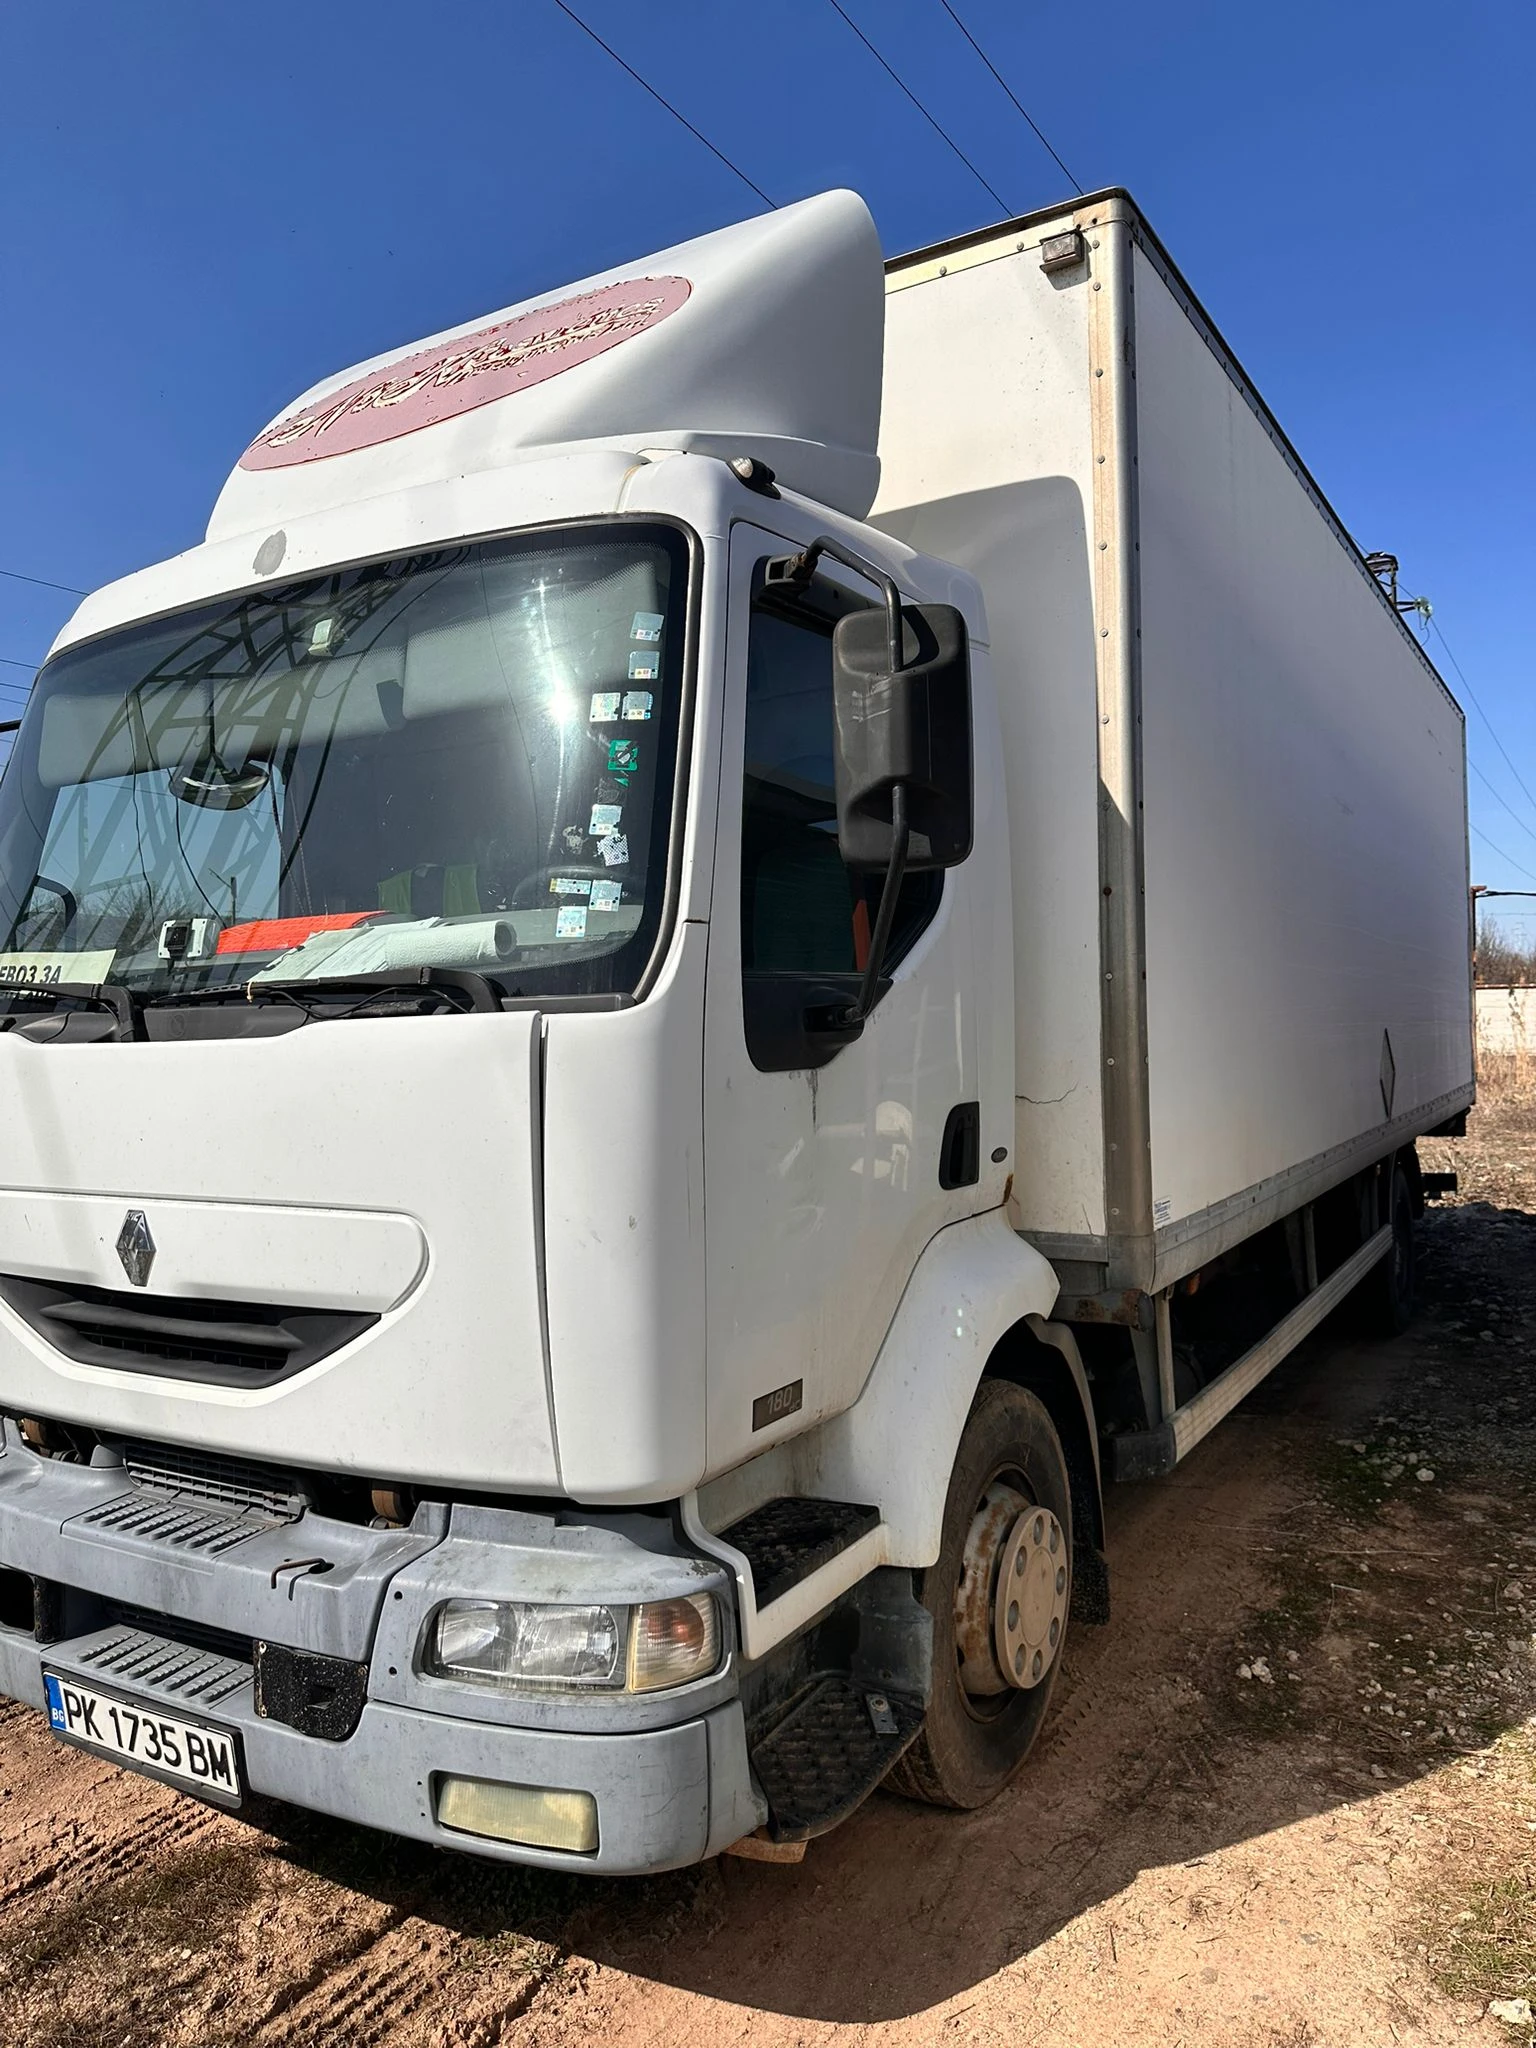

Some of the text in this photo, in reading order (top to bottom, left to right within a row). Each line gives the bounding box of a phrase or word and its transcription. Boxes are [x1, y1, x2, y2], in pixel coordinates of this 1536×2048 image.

[767, 1386, 793, 1415] 180
[52, 1708, 65, 1723] BG
[63, 1688, 234, 1787] PK 1735 BM
